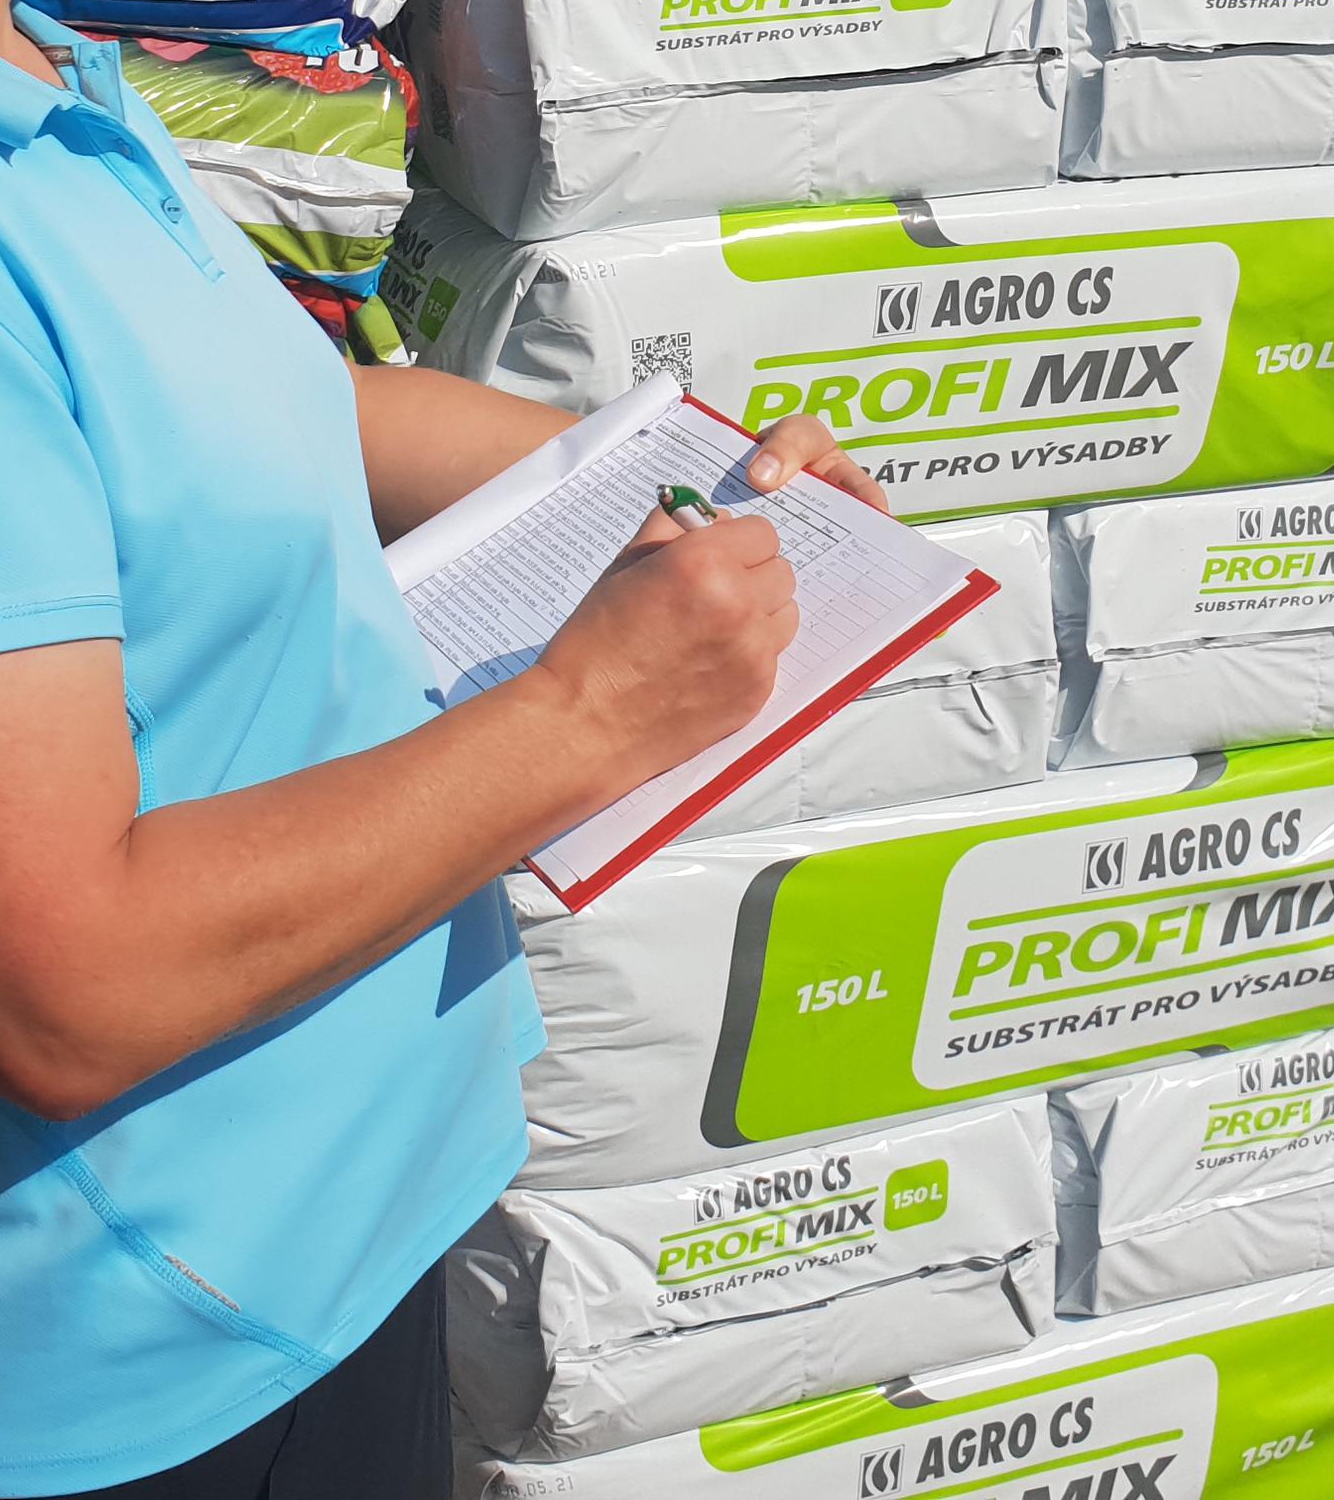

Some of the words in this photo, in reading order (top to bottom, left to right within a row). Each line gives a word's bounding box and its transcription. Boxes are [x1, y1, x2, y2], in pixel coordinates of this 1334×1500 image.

[655, 30, 752, 52] SUBSTRÁT
[756, 27, 795, 43] PRO
[799, 18, 883, 40] VÝSADBY
[931, 271, 1055, 328] AGRO
[1067, 267, 1114, 315] CS
[741, 357, 1012, 433] PROFI
[1021, 341, 1193, 408] MIX
[924, 453, 1000, 479] PRO
[1010, 434, 1172, 471] VÝSADBY
[1200, 553, 1314, 583] PROFI
[1193, 597, 1277, 613] SUBSTRÁT
[1279, 595, 1314, 607] PRO
[1139, 817, 1251, 882] AGRO
[1262, 809, 1302, 857] CS
[952, 903, 1210, 997] PROFI
[945, 1004, 1126, 1059] SUBSTRÁT
[1132, 990, 1199, 1020] PRO
[1204, 1100, 1310, 1142] PROFI
[734, 1167, 813, 1214] AGRO
[821, 1155, 851, 1192] CS
[656, 1221, 785, 1275] PROFI
[796, 1199, 877, 1243] MIX
[656, 1275, 748, 1307] SUBSTRÁT
[751, 1264, 789, 1282] PRO
[795, 1243, 878, 1272] VÝSADBY
[915, 1412, 1036, 1483] AGRO
[1050, 1397, 1094, 1448] CS
